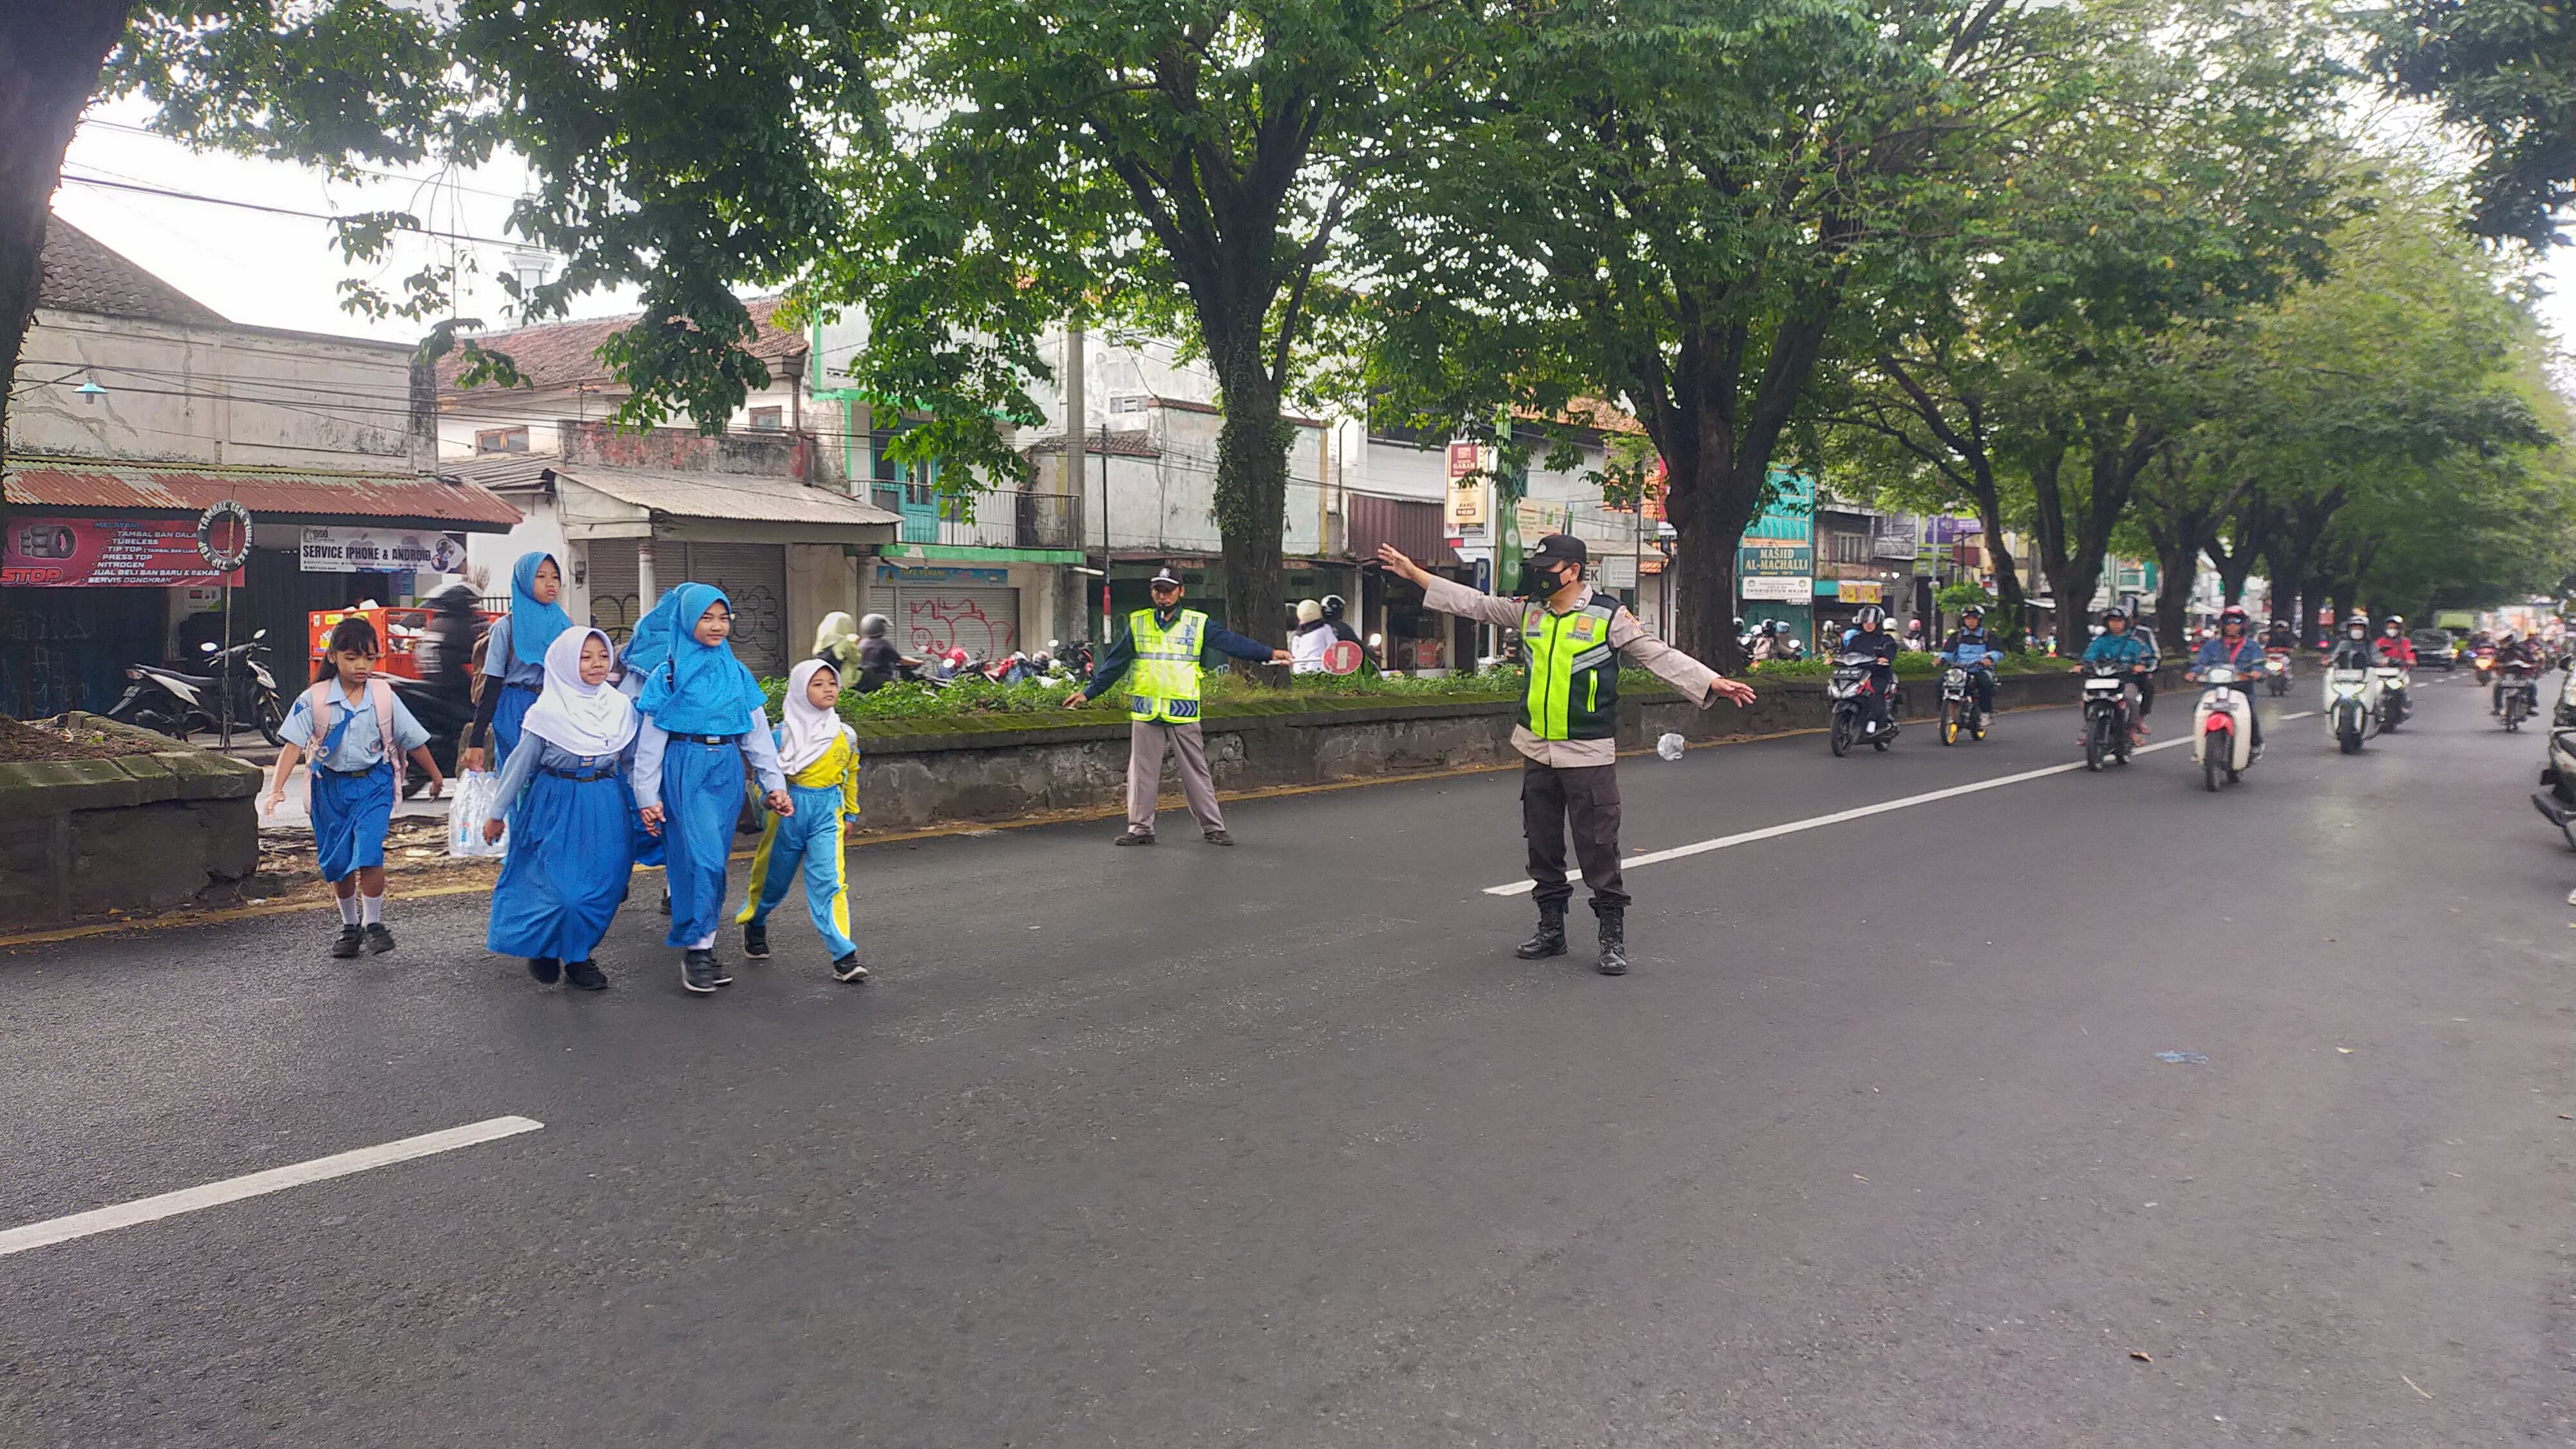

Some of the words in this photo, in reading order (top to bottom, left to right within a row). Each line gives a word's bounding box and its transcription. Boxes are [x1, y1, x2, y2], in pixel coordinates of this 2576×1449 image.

[198, 502, 228, 530] TAMBAL
[230, 502, 245, 520] BAN
[198, 542, 211, 561] TOP
[303, 545, 343, 558] SERVICE
[346, 546, 379, 560] IPHONE
[383, 549, 388, 560] &
[392, 548, 431, 562] ANDROID
[1760, 548, 1794, 559] MASJID
[211, 558, 227, 570] TIP
[1746, 559, 1808, 570] AL-MACHALLI
[1, 568, 62, 583] STOP
[1477, 562, 1487, 589] P
